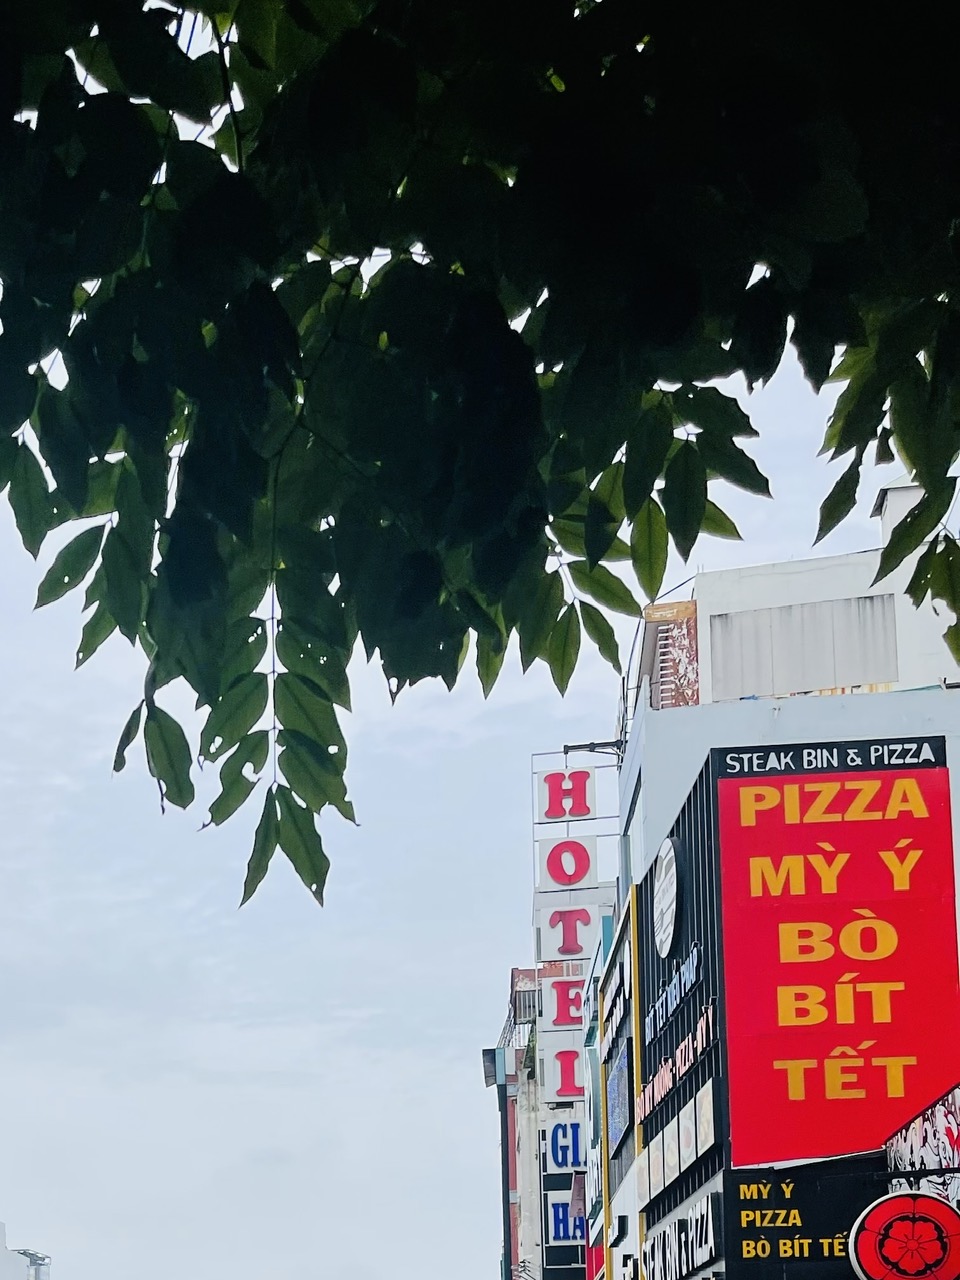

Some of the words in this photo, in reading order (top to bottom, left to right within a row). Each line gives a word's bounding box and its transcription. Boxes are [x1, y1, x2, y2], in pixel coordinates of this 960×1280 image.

[726, 752, 796, 773] STEAK
[803, 748, 838, 770] BIN
[846, 749, 862, 766] &
[870, 742, 935, 766] PIZZA
[739, 778, 930, 827] PIZZA
[749, 842, 851, 897] MỲ
[878, 838, 924, 891] Ý
[778, 909, 898, 963] BÒ
[777, 972, 905, 1027] BÍT
[773, 1040, 918, 1100] TẾT
[551, 1123, 587, 1169] GI
[739, 1180, 772, 1200] MỲ
[781, 1179, 795, 1199] Ý
[688, 1192, 715, 1271] PIZZA
[740, 1209, 802, 1228] PIZZA
[742, 1235, 771, 1259] BÒ
[779, 1234, 813, 1258] BÍT
[819, 1232, 850, 1257] TẾ
